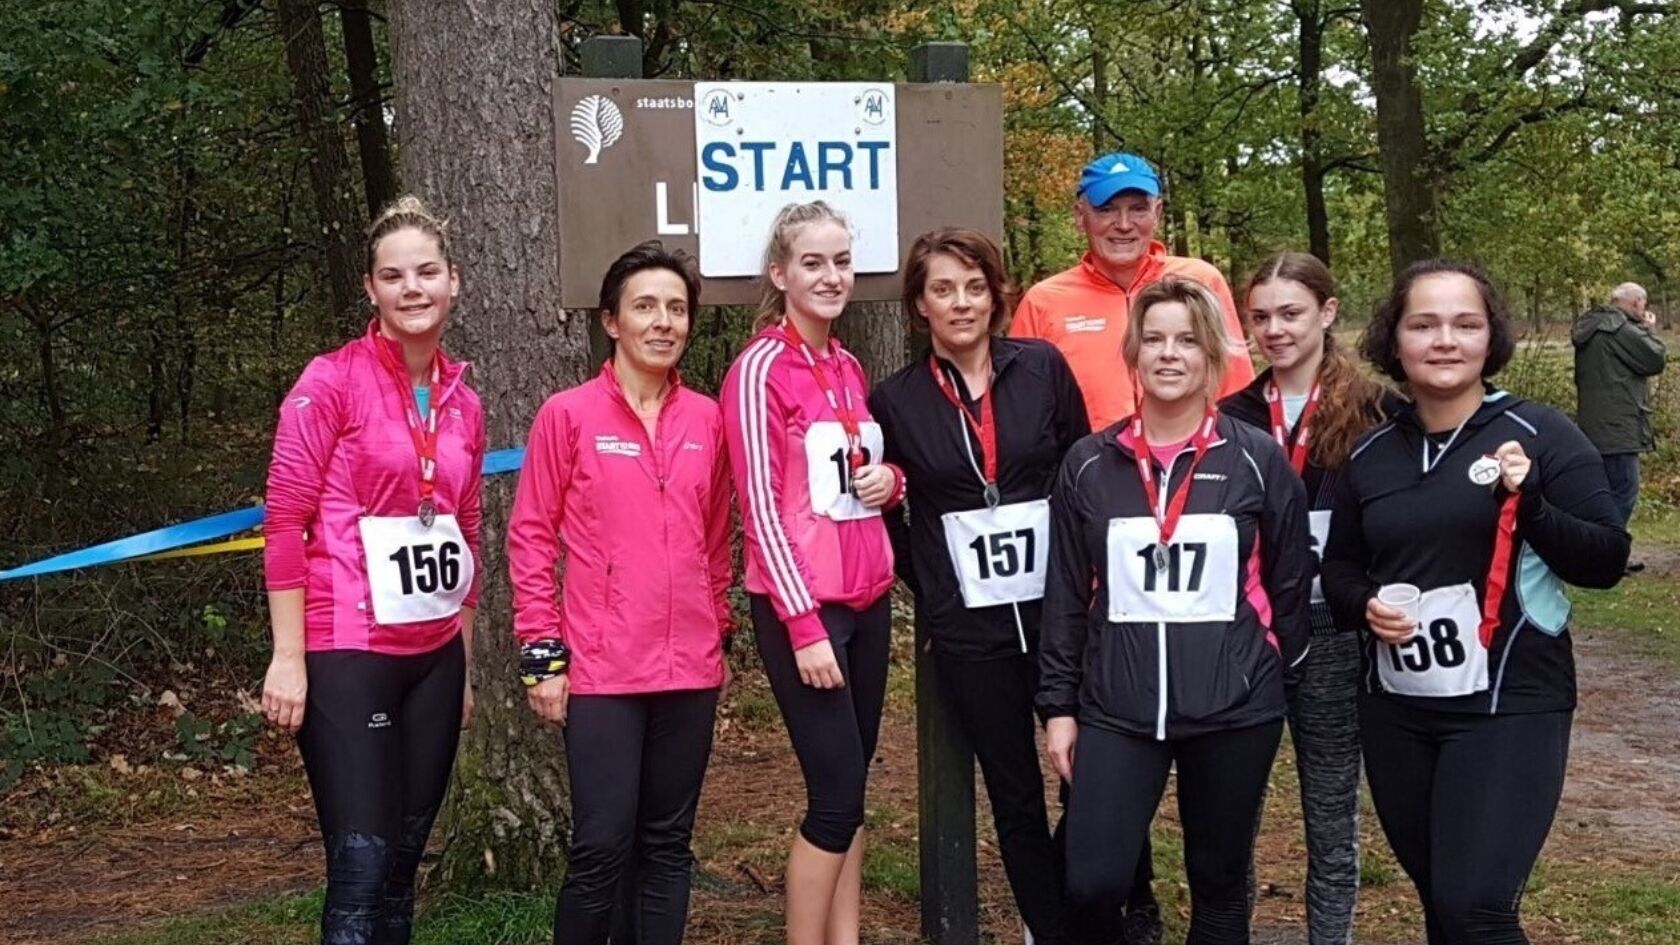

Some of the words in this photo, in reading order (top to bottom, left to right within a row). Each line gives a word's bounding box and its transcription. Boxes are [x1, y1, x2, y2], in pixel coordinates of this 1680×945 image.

[636, 97, 694, 109] staatsbo
[702, 141, 890, 192] START
[389, 541, 461, 596] 156
[969, 527, 1036, 580] 157
[1136, 542, 1208, 592] 117
